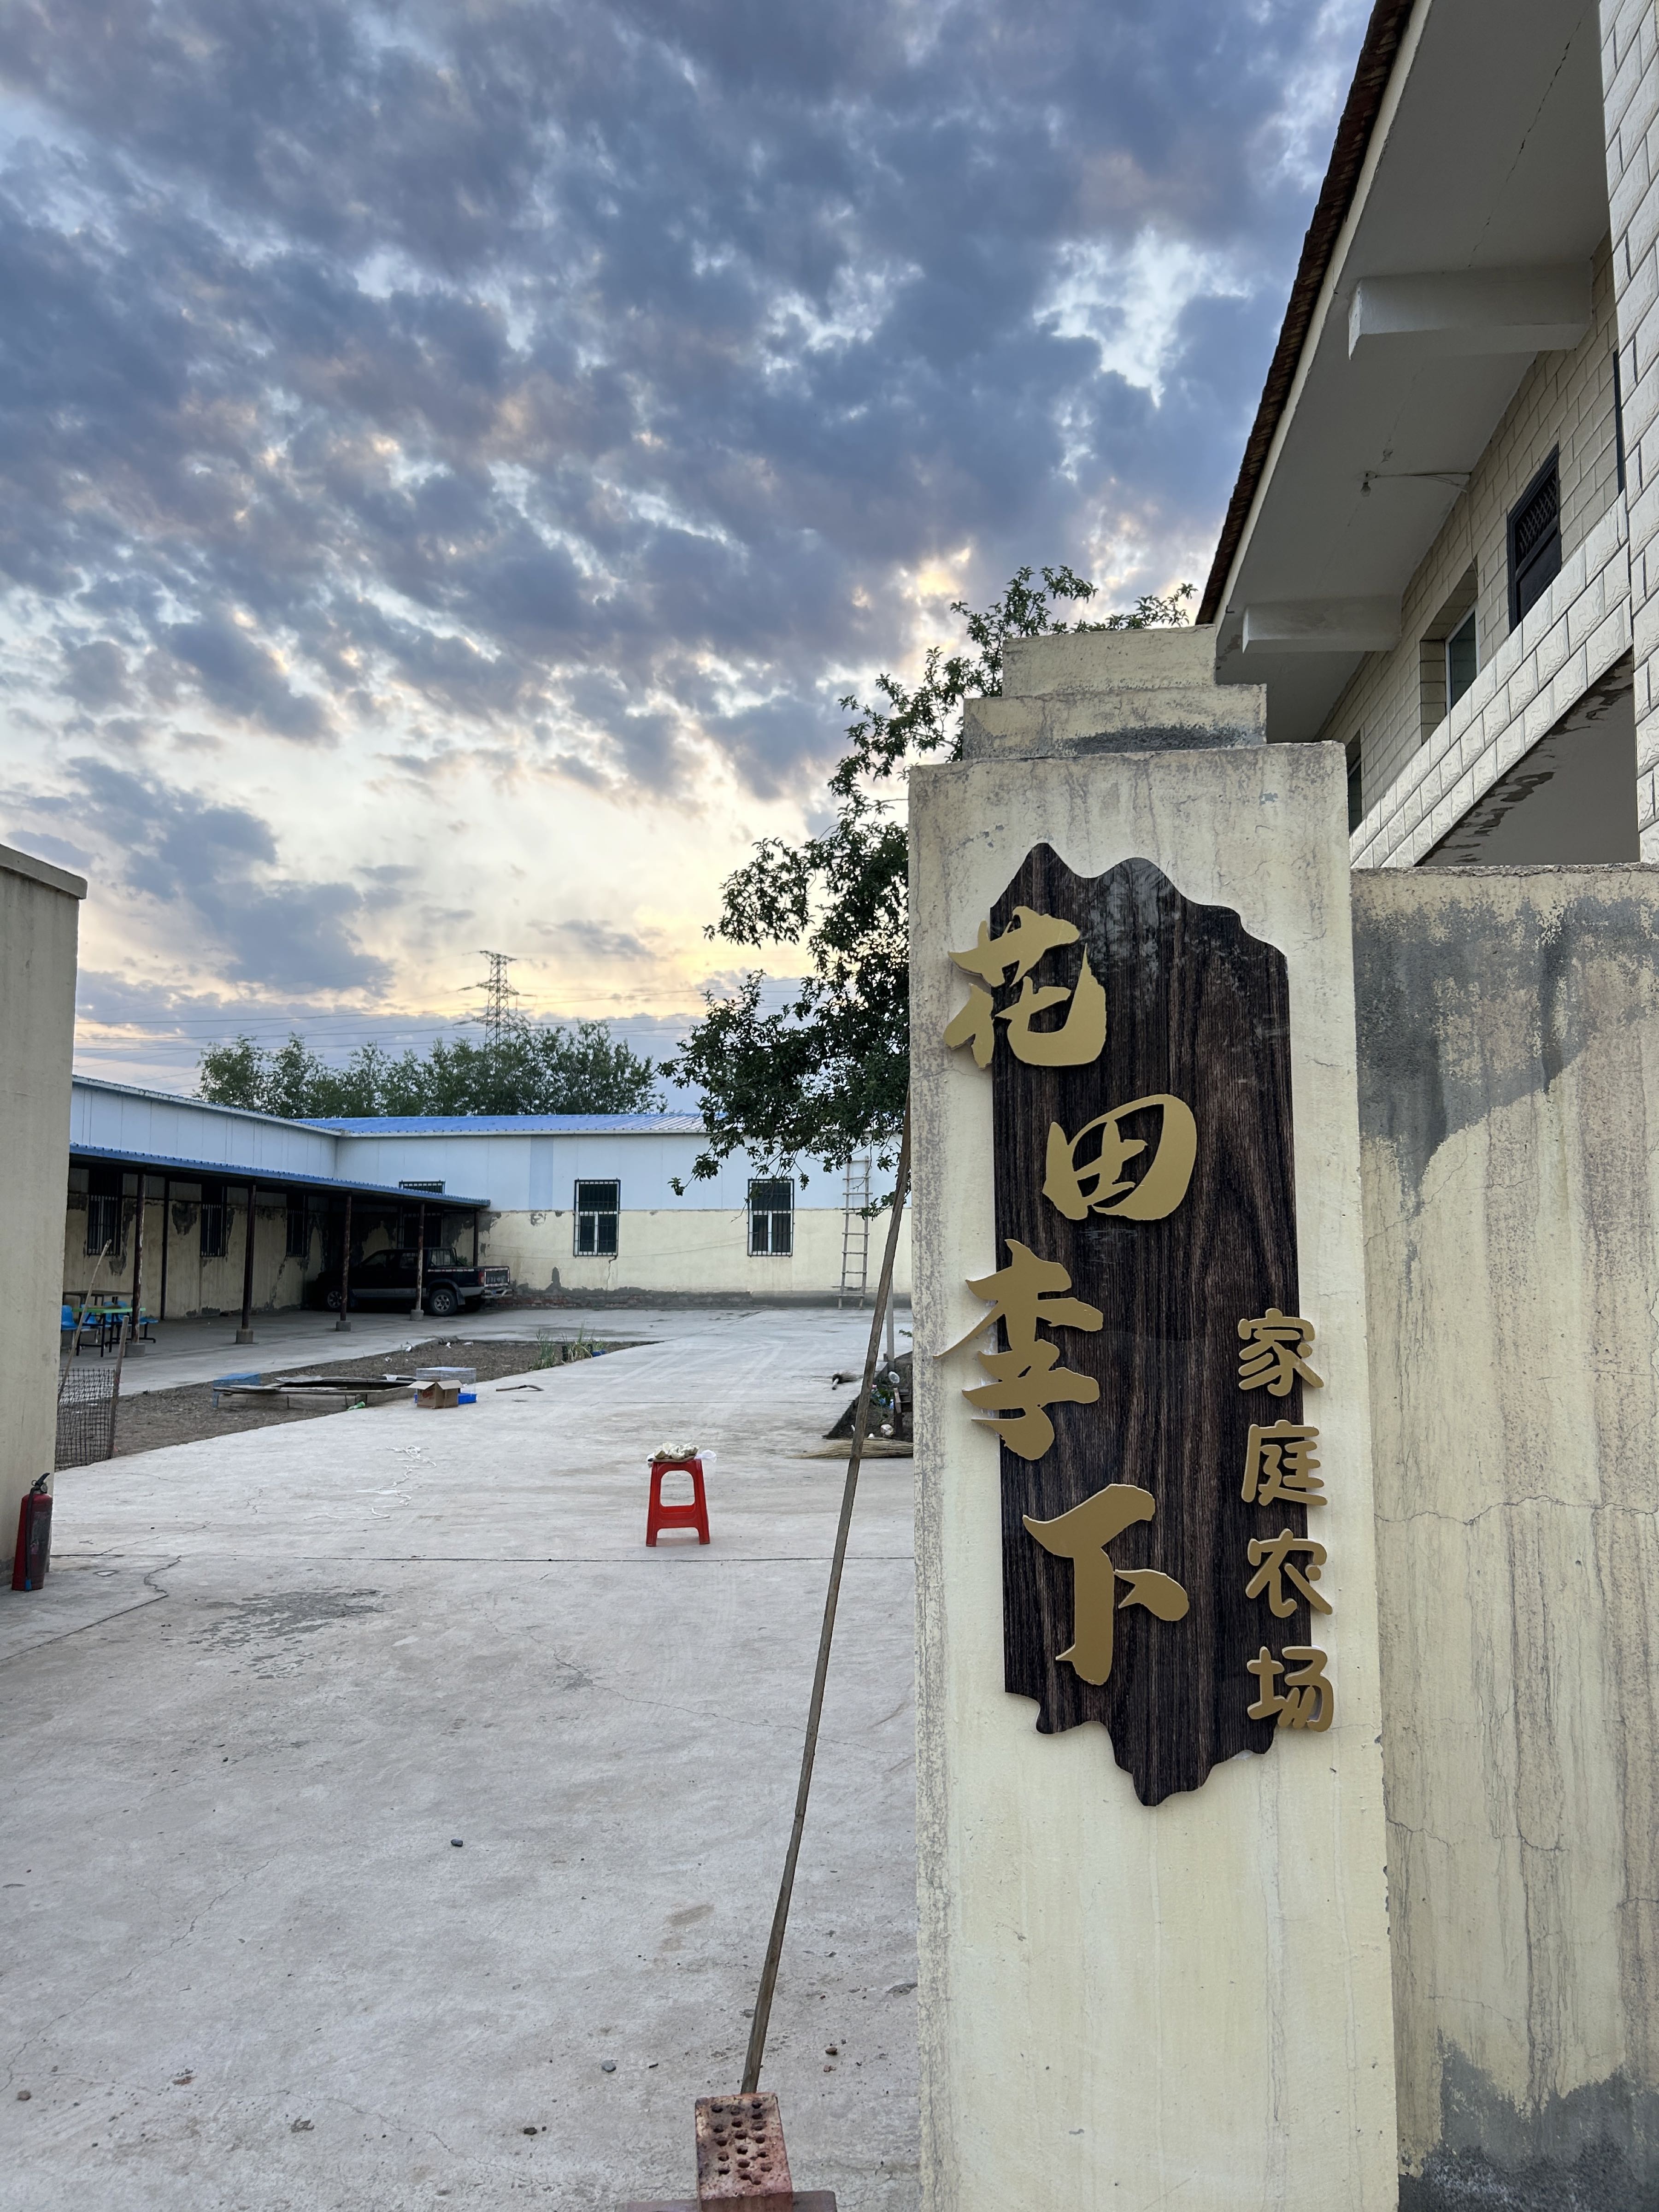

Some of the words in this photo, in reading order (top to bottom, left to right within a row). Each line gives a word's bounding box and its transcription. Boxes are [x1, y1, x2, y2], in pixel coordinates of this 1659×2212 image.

[935, 906, 1197, 1685] 花田李下
[1238, 1308, 1334, 1732] 家庭农场
